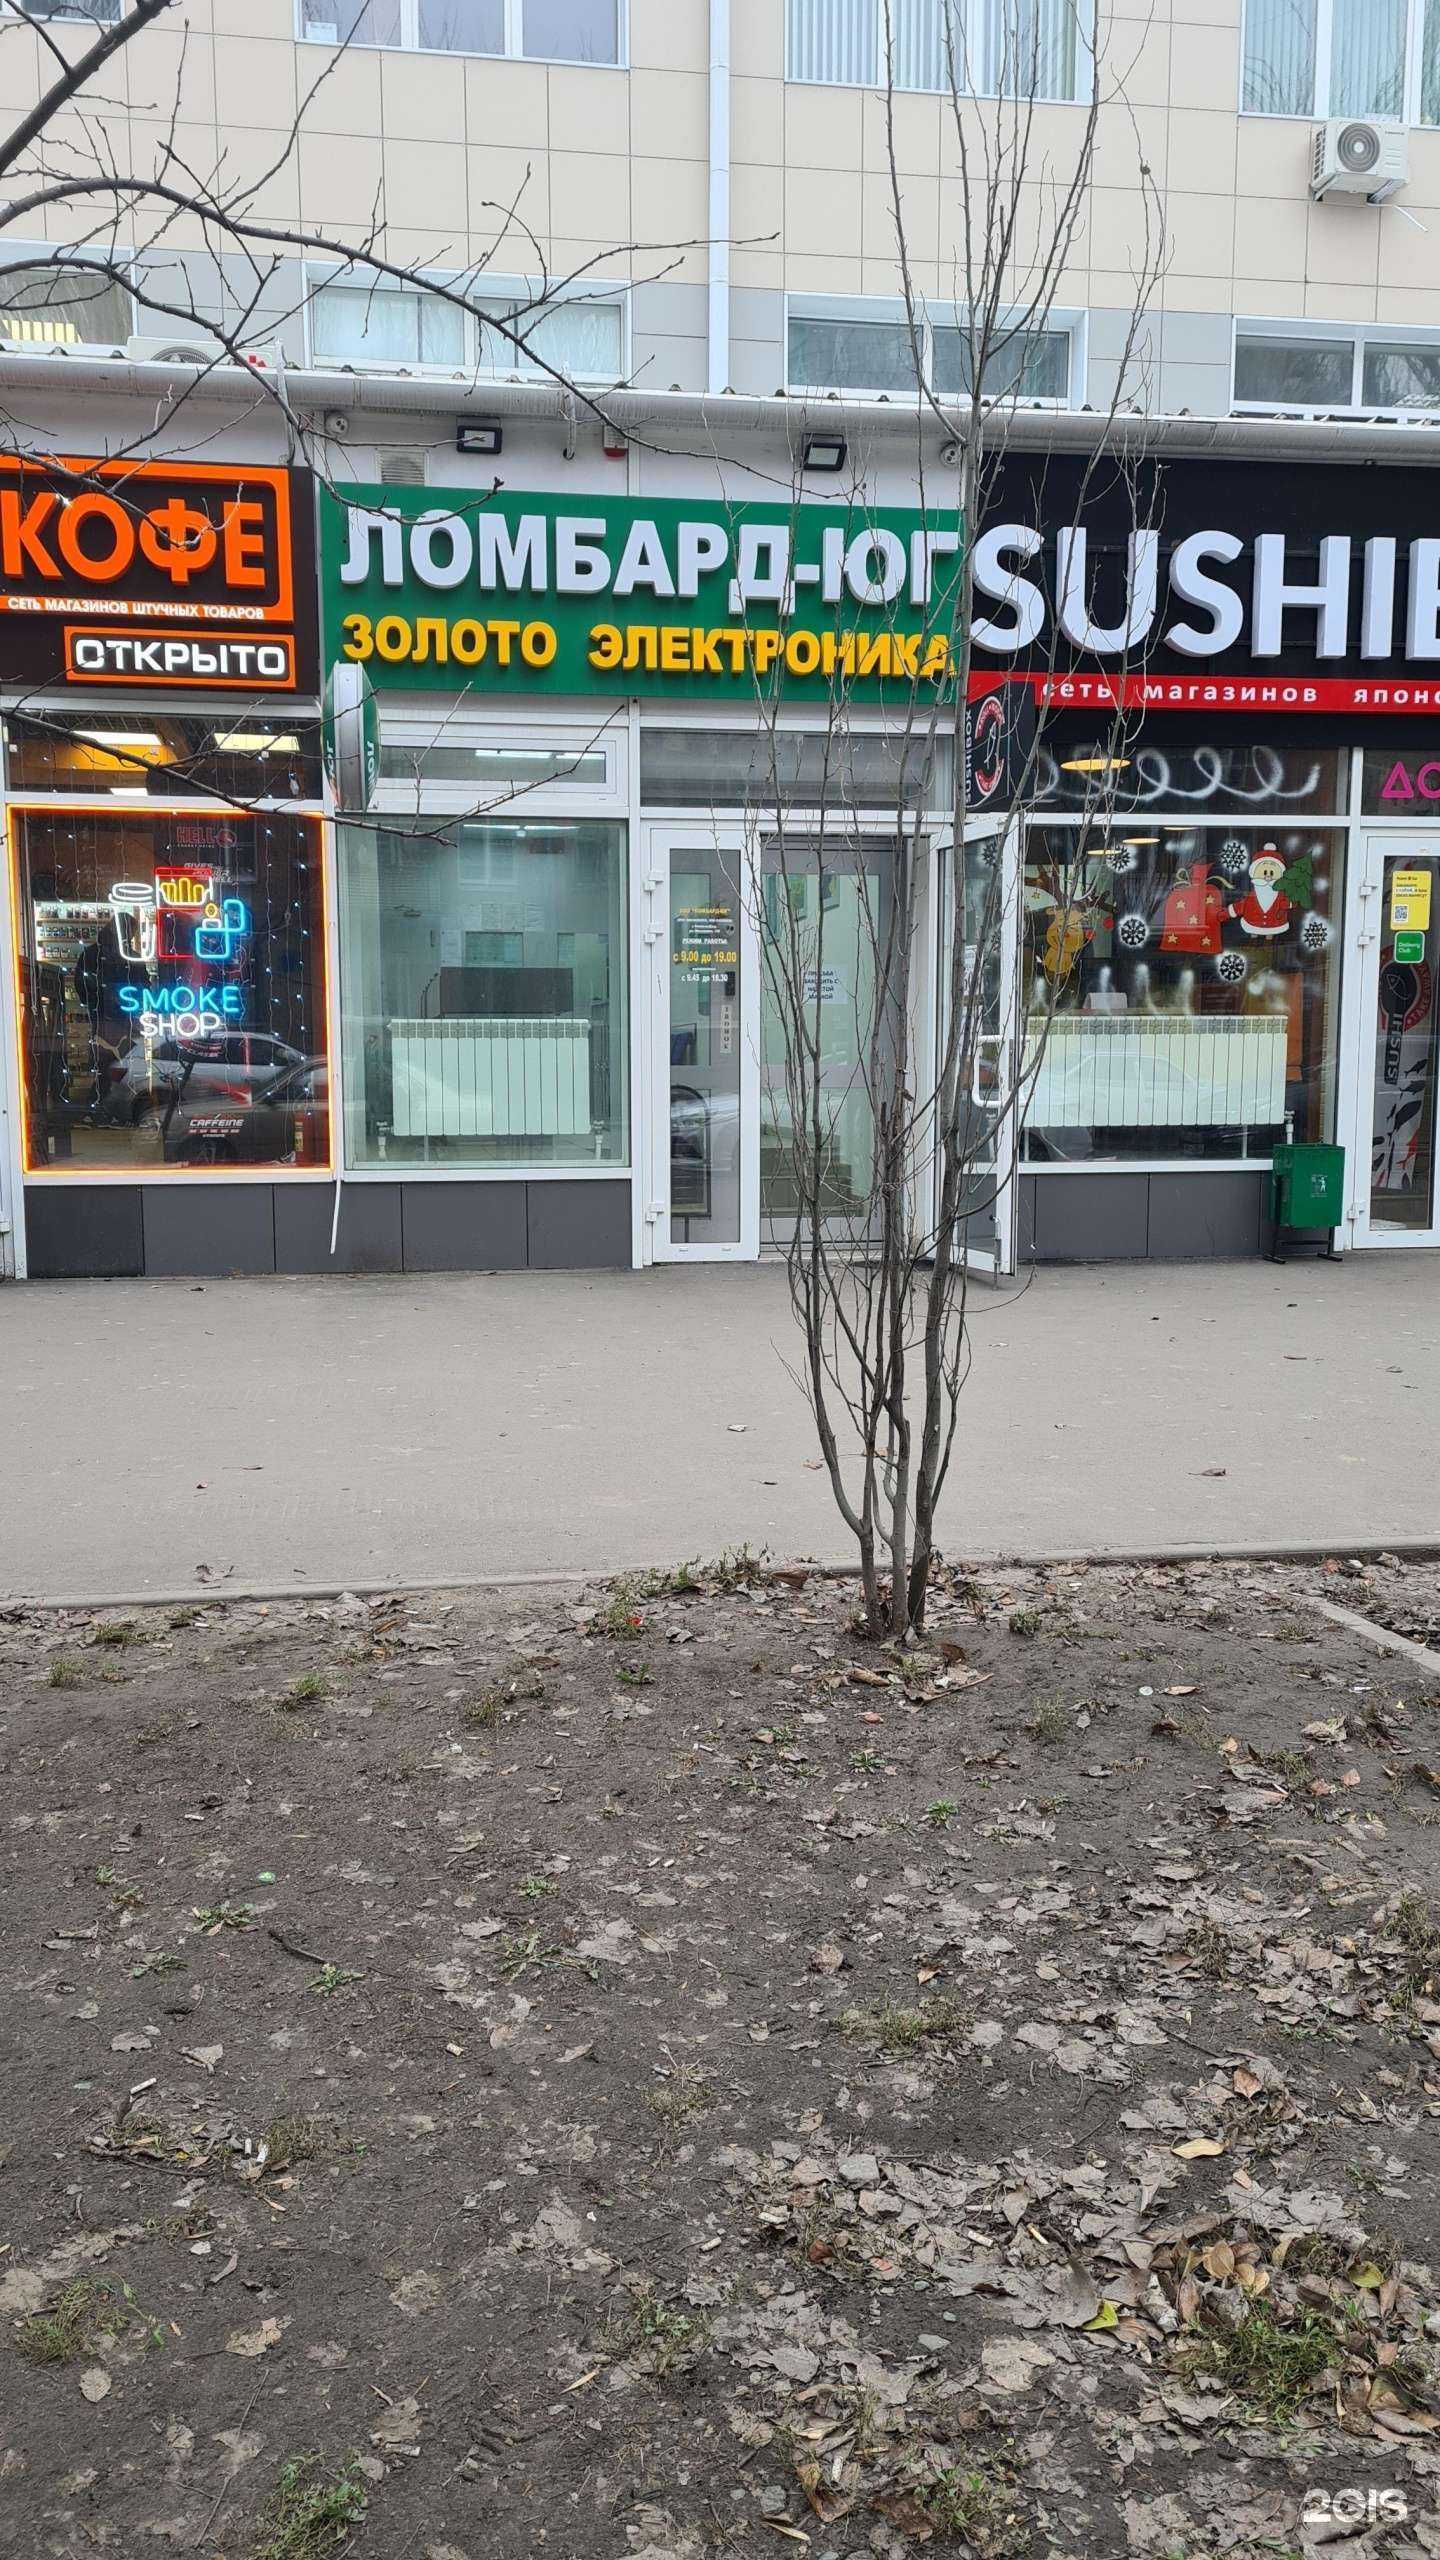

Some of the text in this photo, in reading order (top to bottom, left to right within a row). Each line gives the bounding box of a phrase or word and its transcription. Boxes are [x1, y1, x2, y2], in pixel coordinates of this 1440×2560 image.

[0, 490, 265, 587] КОФЕ
[340, 505, 958, 615] ЛОМБАРД-ЮГ
[8, 597, 264, 620] СЕТЬ МАГАЗИНОВ ШТУЧНЫХ ТОВАРОВ
[75, 639, 285, 676] ОТКРЫТО
[343, 613, 957, 678] ЗОЛОТО ЭЛЕКТРОНИКА
[1042, 682, 1112, 699] сеть
[1143, 684, 1318, 702] магазинов
[119, 986, 240, 1013] SMOKE
[139, 1011, 221, 1038] SHOP
[1388, 1013, 1404, 1079] SUSHI
[189, 1119, 245, 1127] CAFFEINE
